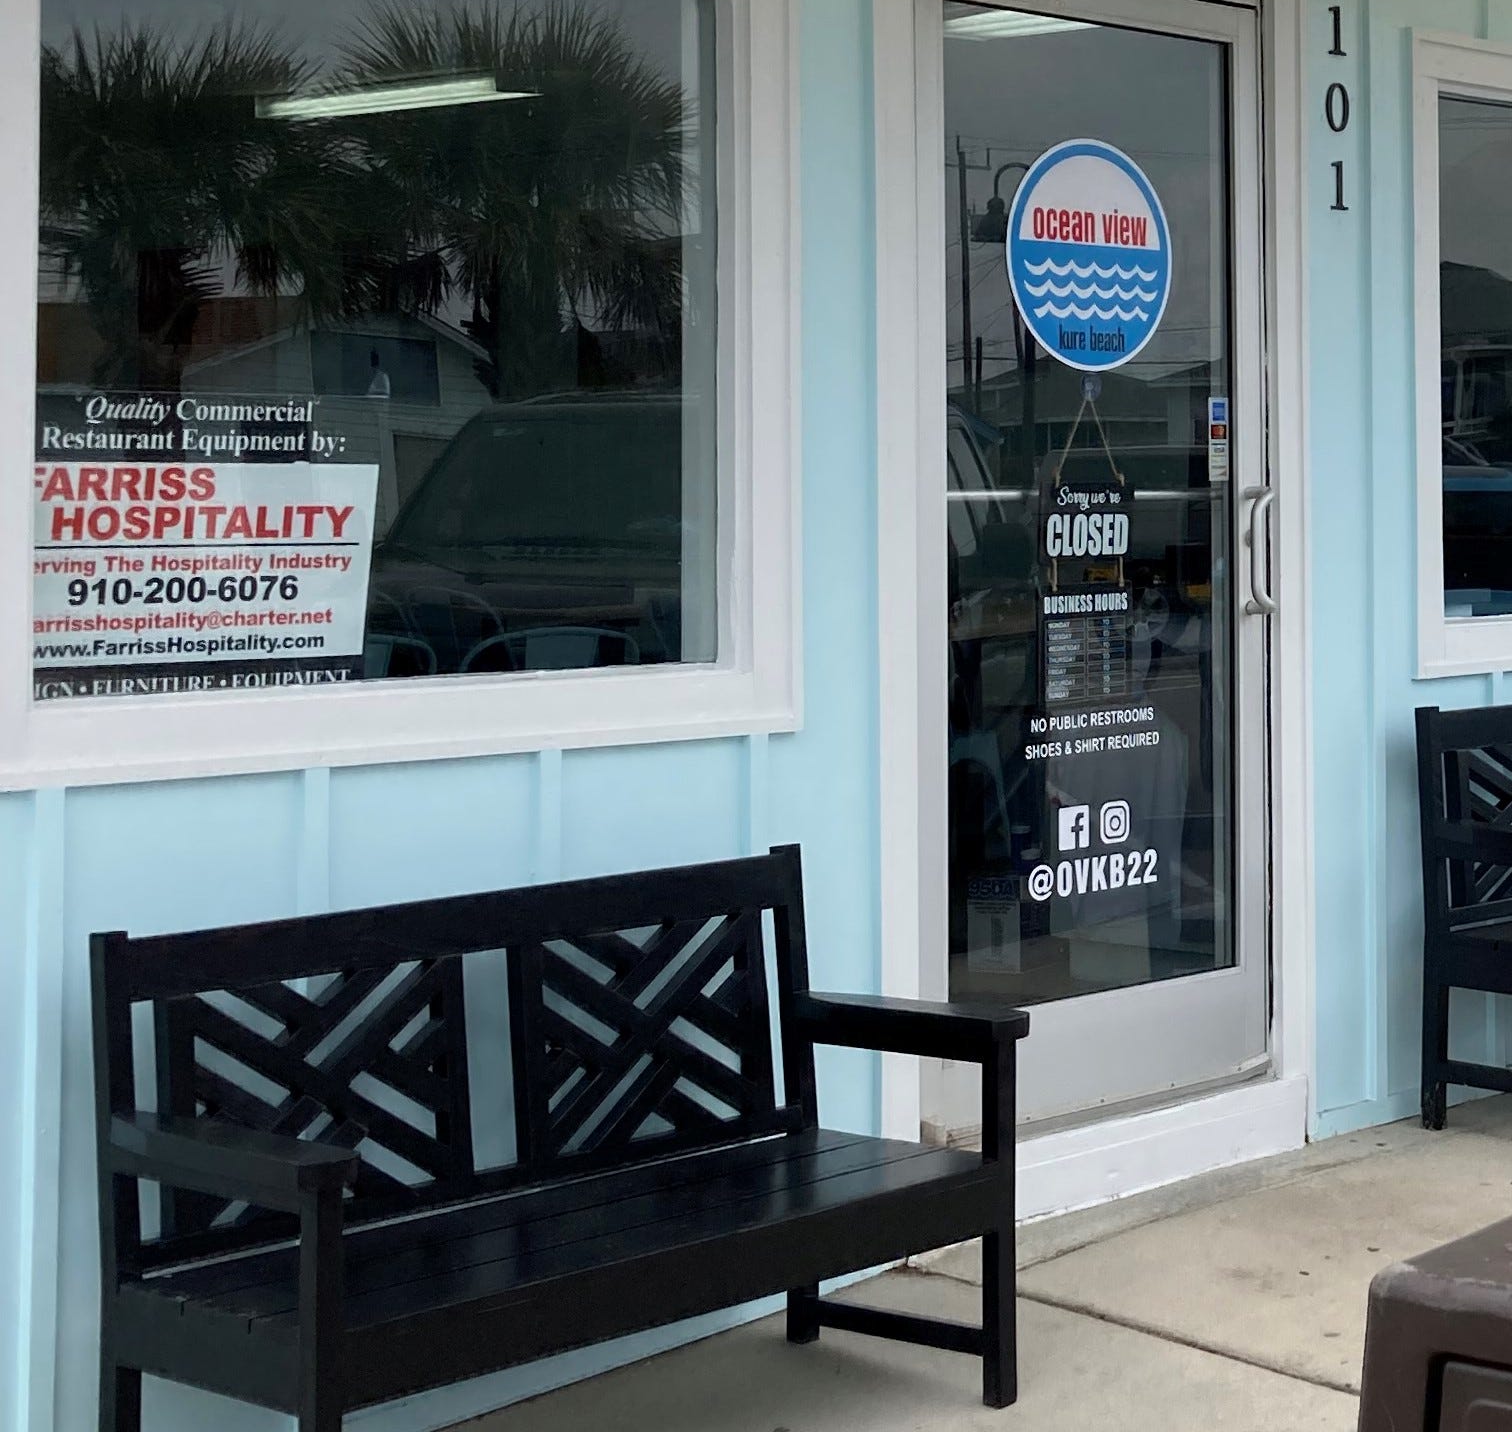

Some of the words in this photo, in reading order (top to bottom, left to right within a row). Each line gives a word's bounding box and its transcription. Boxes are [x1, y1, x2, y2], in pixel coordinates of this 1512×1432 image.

[1325, 5, 1349, 211] 101
[1033, 206, 1096, 243] ocean
[1102, 209, 1147, 246] view
[1059, 324, 1086, 350] kure
[1090, 325, 1125, 352] beach
[85, 396, 171, 425] Quality
[176, 398, 313, 422] Commercial
[42, 427, 175, 450] Restaurant
[181, 429, 305, 456] Equipment
[311, 431, 346, 457] by:
[1057, 486, 1090, 510] Sorry
[51, 506, 354, 541] HOSPITALITY
[1047, 513, 1129, 557] CLOSED
[104, 555, 143, 572] The
[151, 554, 263, 575] Hospitality
[269, 552, 352, 571] Industry
[68, 575, 299, 606] 910-200-6076
[1044, 594, 1093, 614] BUSINESS
[1095, 592, 1128, 612] HOURS
[1031, 718, 1047, 733] NO
[1049, 714, 1087, 731] PUBLIC
[1090, 707, 1154, 727] RESTROOMS
[1025, 742, 1062, 760] SHOES
[1065, 741, 1072, 755] &
[1075, 737, 1105, 754] SHIRT
[1108, 731, 1160, 750] REQUIRED
[1028, 849, 1158, 901] @OVKB22
